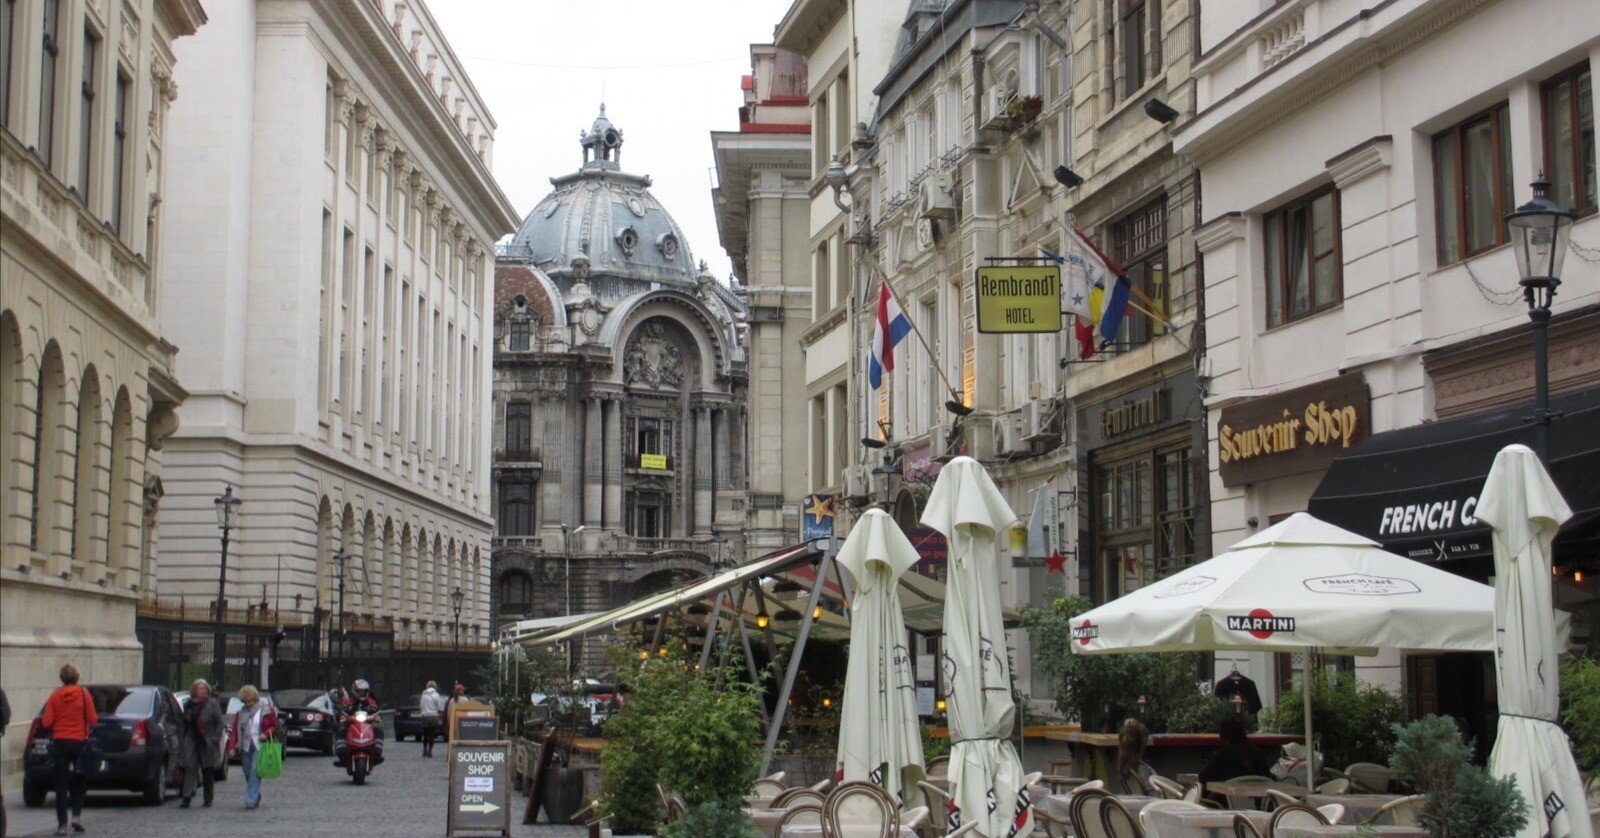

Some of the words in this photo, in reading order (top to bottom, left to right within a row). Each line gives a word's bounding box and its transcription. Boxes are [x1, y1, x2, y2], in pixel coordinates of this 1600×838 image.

[1006, 307, 1035, 324] HOTEL
[1220, 408, 1300, 464] Souvenir
[1304, 400, 1358, 448] Shop
[1379, 499, 1457, 535] FRENCH
[1229, 617, 1294, 630] MARTINI
[1073, 626, 1098, 639] MARTINI
[457, 752, 504, 763] SOUVENIR
[468, 765, 494, 775] SHOP
[461, 794, 483, 803] OPEN
